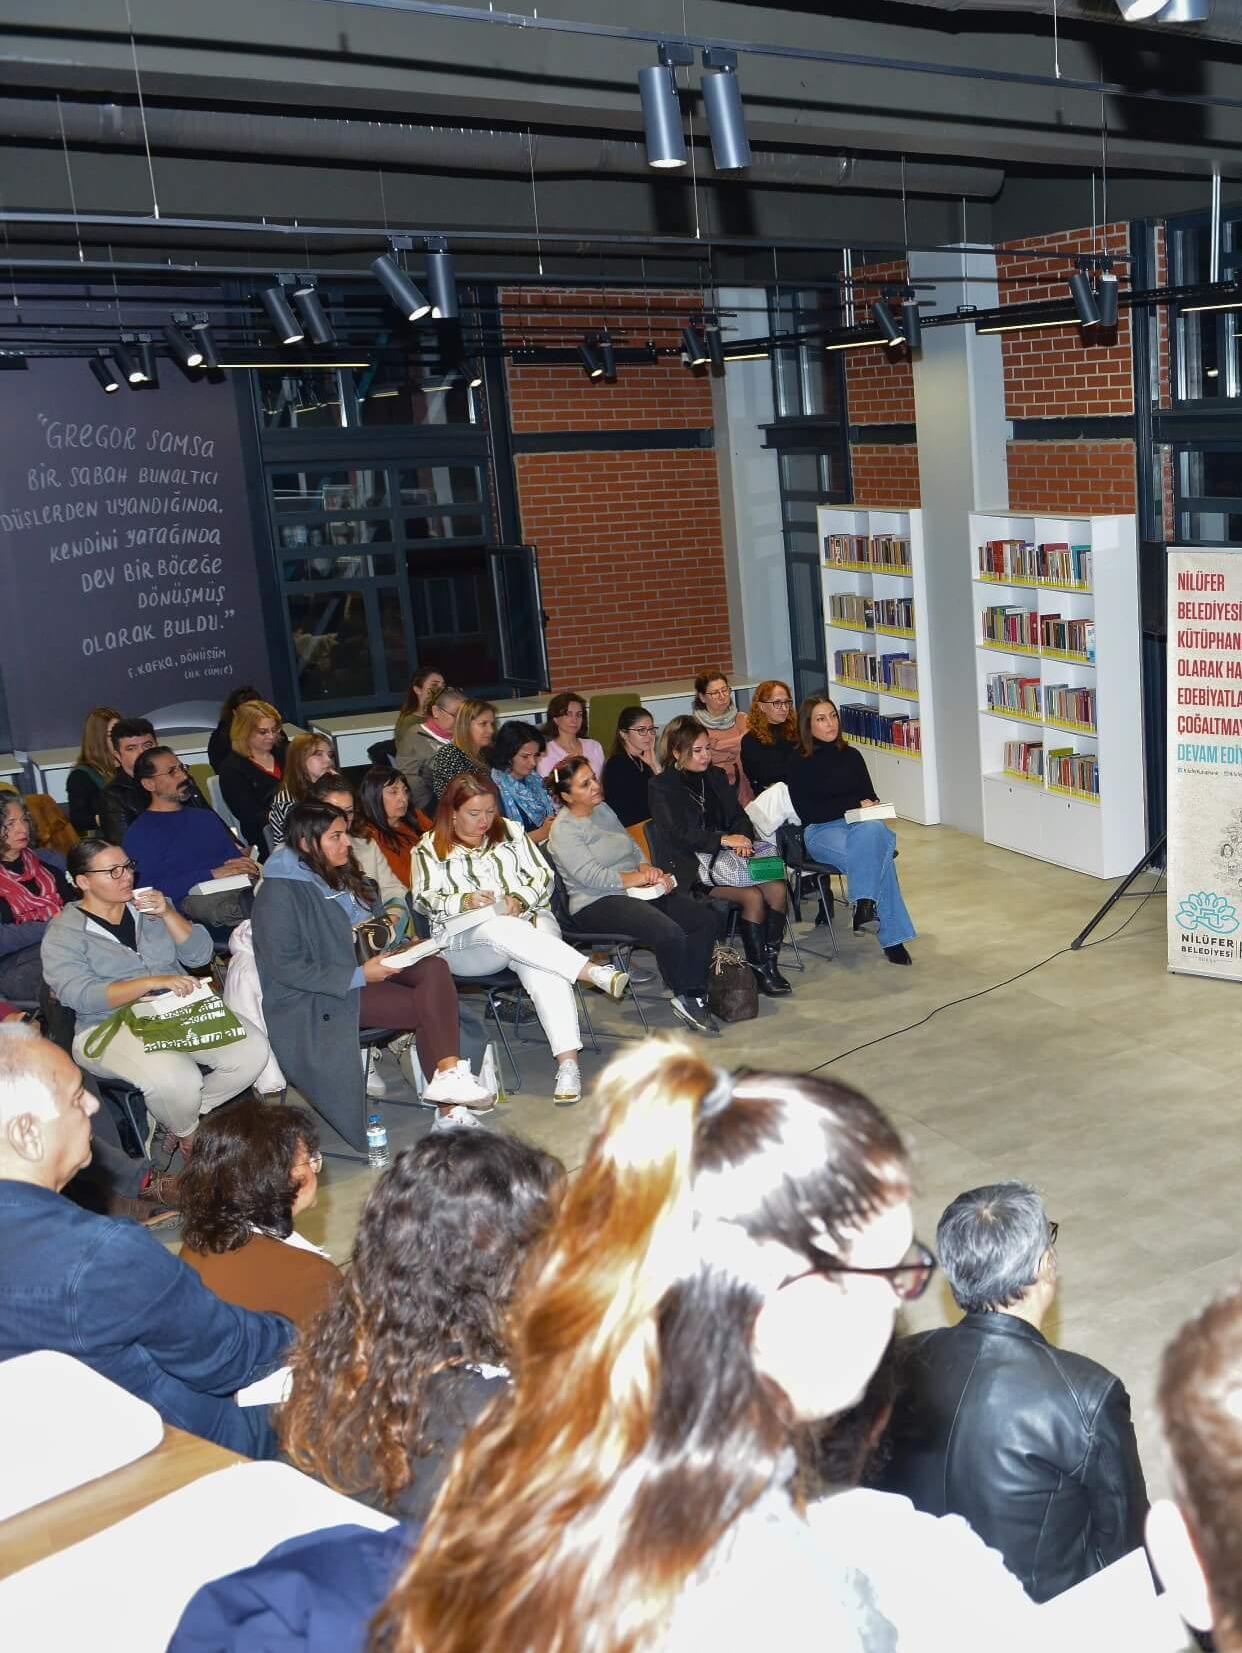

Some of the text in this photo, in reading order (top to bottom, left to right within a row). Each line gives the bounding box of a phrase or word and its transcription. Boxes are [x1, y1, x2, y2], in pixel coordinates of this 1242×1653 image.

[123, 558, 154, 582] BİR
[1177, 570, 1225, 592] NİLÜFER
[1177, 599, 1242, 621] BELEDİYESİ
[1177, 659, 1223, 678] OLARAK
[1177, 744, 1218, 763] DEVAM
[1181, 932, 1234, 948] NİLÜFER
[1181, 946, 1233, 958] BELEDİYESİ
